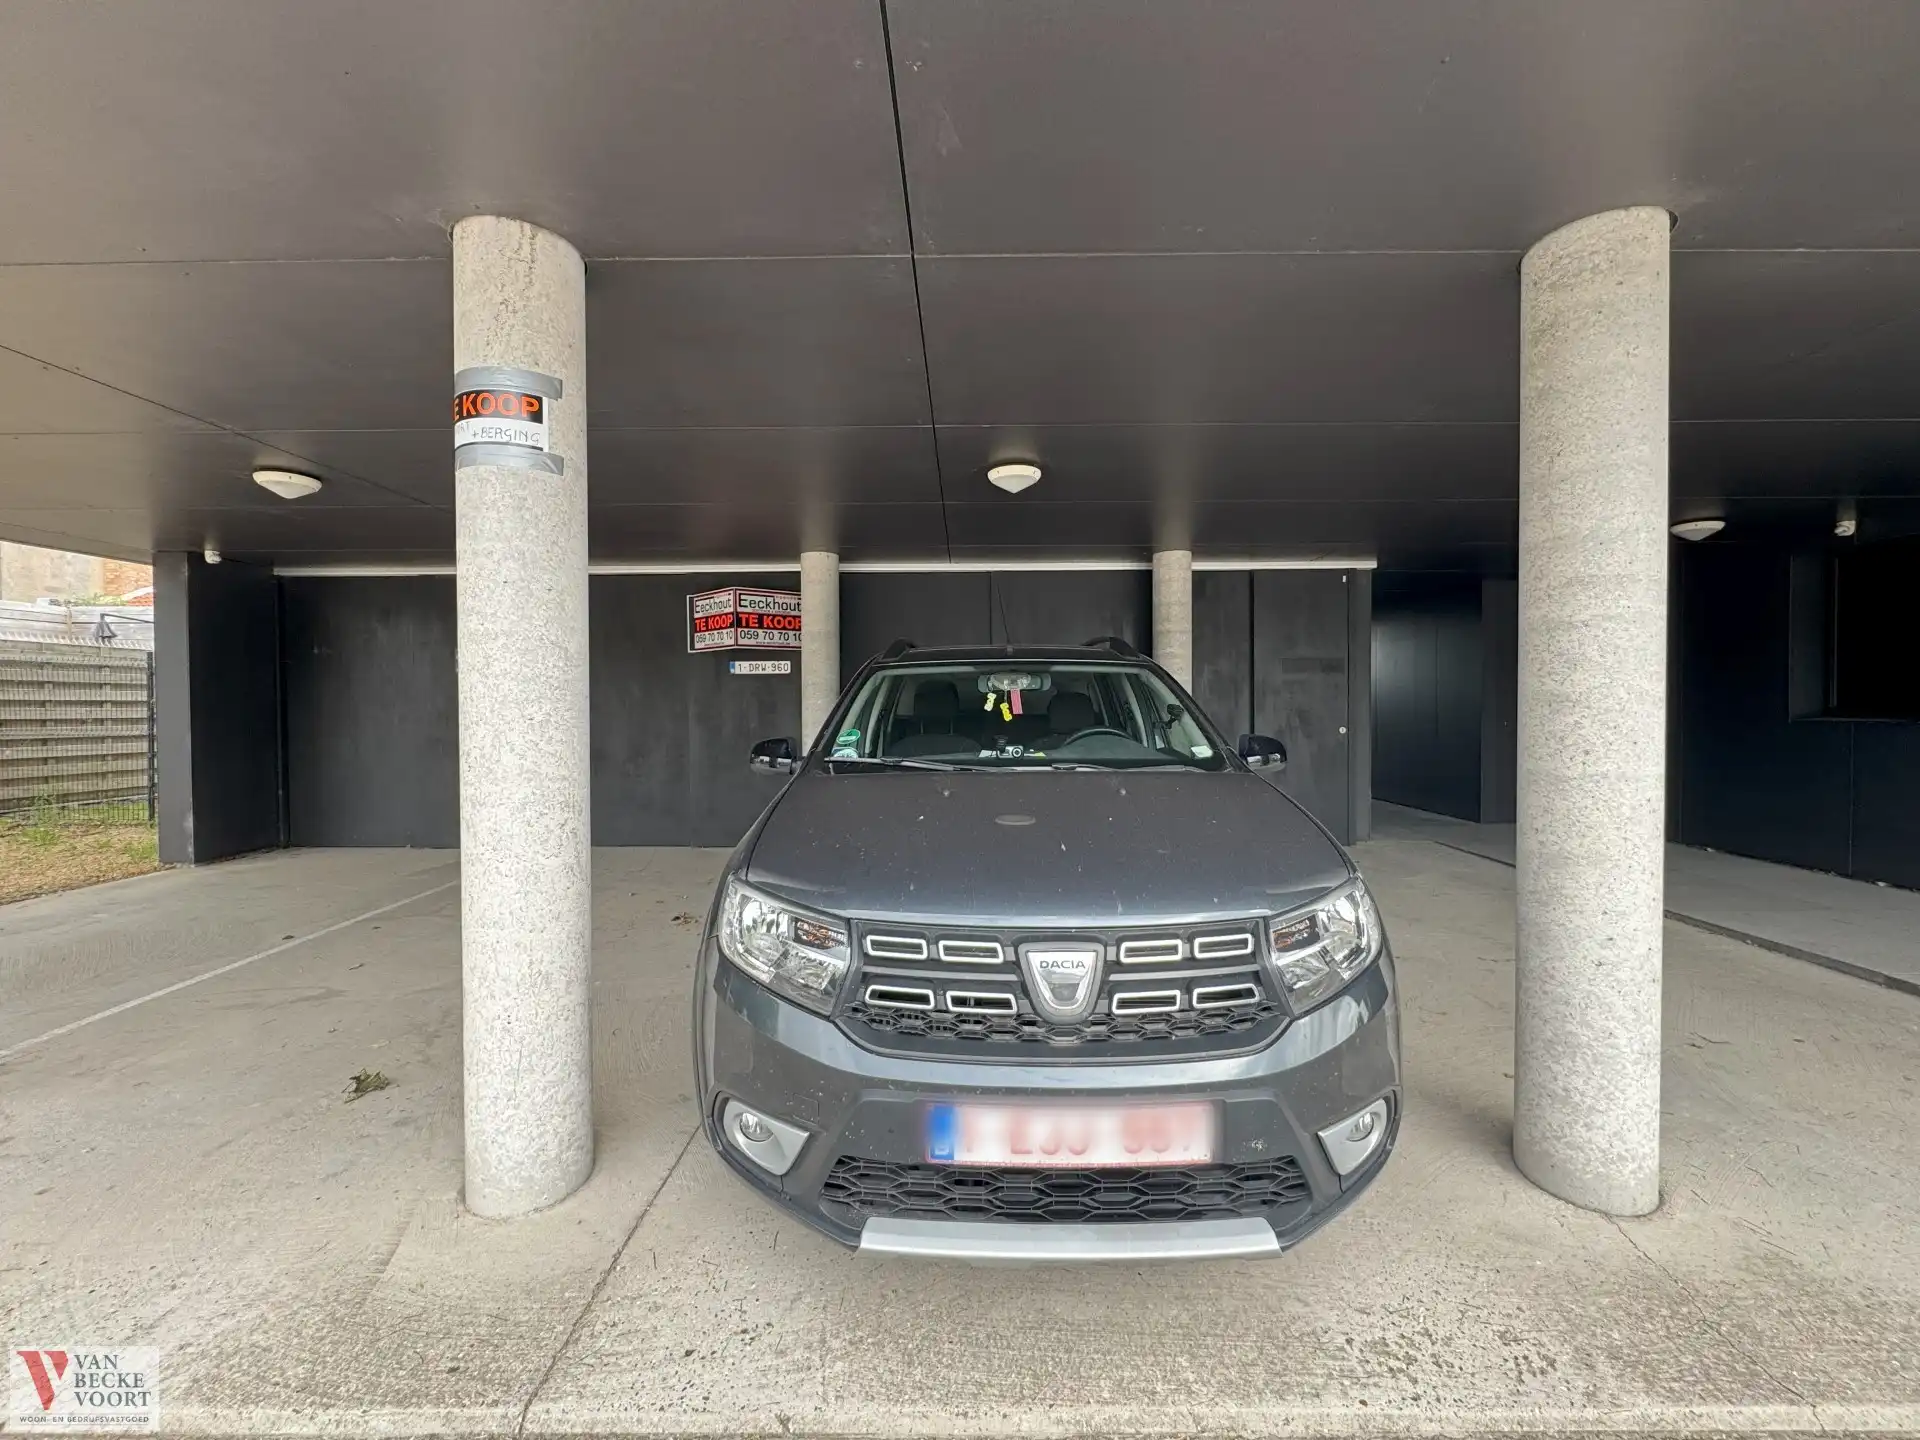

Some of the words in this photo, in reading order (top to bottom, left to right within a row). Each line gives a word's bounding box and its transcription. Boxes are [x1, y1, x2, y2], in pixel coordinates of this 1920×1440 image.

[462, 392, 540, 418] KOOP
[695, 596, 732, 614] Eeckhout
[738, 592, 801, 612] Eeckhout
[695, 618, 707, 632] TE
[708, 614, 733, 630] KOOP
[739, 614, 759, 628] TE
[763, 615, 801, 630] KOOP
[696, 633, 707, 643] 059
[708, 632, 716, 642] 70
[716, 631, 725, 641] 70
[725, 629, 733, 640] 10
[740, 629, 759, 640] 059
[762, 631, 775, 641] 70
[778, 632, 790, 642] 70
[738, 662, 789, 673] 1-DRW-960
[1040, 960, 1086, 969] DACIA
